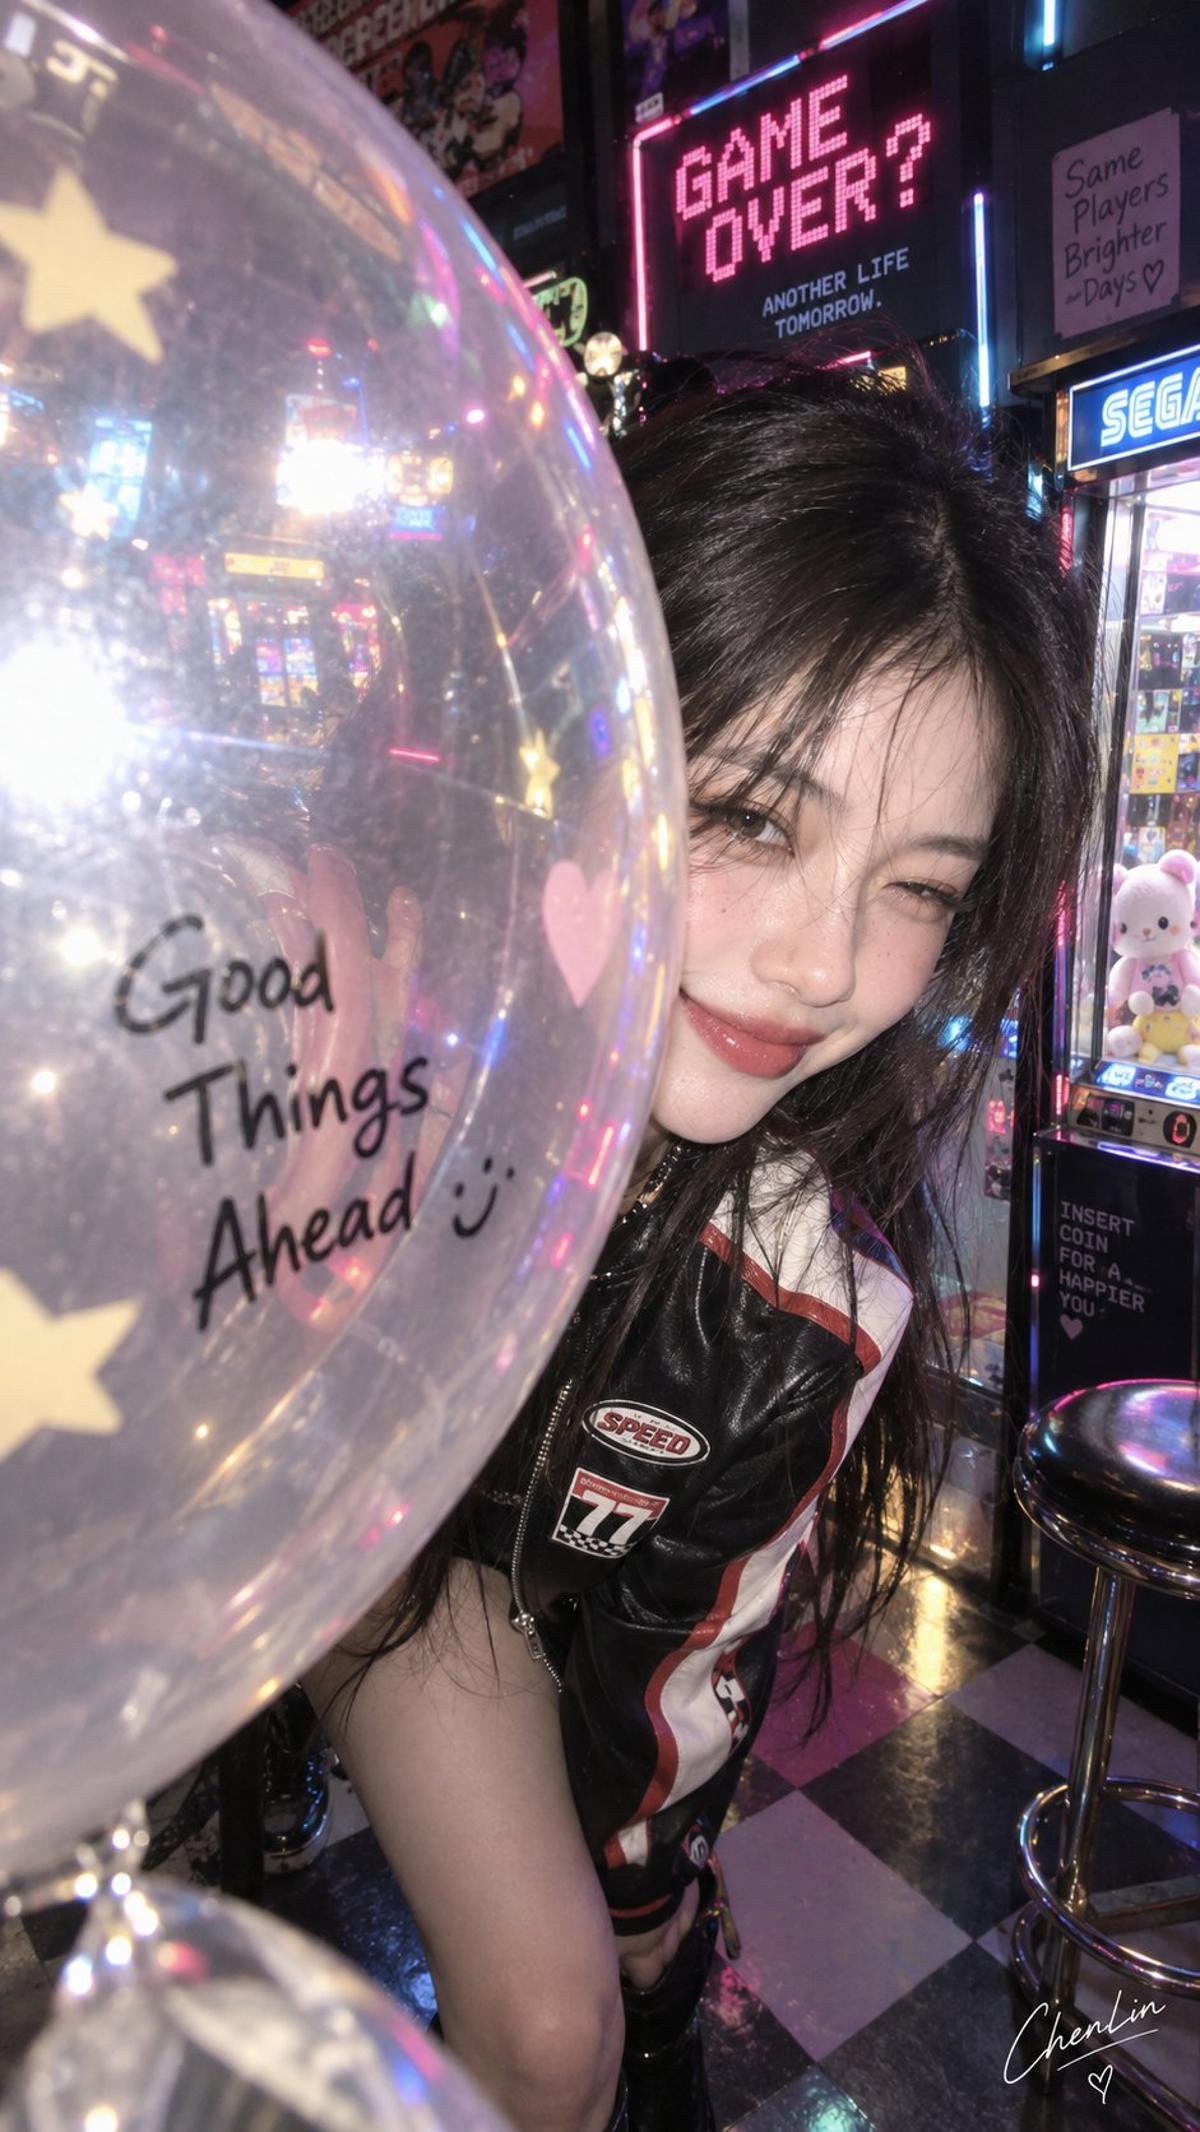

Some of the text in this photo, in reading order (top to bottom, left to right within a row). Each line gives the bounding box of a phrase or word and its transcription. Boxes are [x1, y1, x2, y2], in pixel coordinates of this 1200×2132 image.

[676, 74, 848, 221] GAME
[1065, 147, 1143, 198] Same
[1073, 173, 1168, 235] Players
[1065, 222, 1167, 279] Brighter
[762, 248, 910, 318] ANOTHER LIFE
[775, 290, 882, 339] TOMORROW.
[113, 914, 334, 1044] Good
[164, 1057, 429, 1166] Things
[193, 1152, 417, 1331] Ahead
[1059, 1224, 1108, 1254] COIN
[1060, 1201, 1135, 1237] INSERT
[1059, 1269, 1145, 1313] HAPPIER
[1060, 1247, 1121, 1283] FOR A
[1060, 1291, 1095, 1317] YOU
[597, 1411, 691, 1456] SPEED
[576, 1489, 654, 1545] 77
